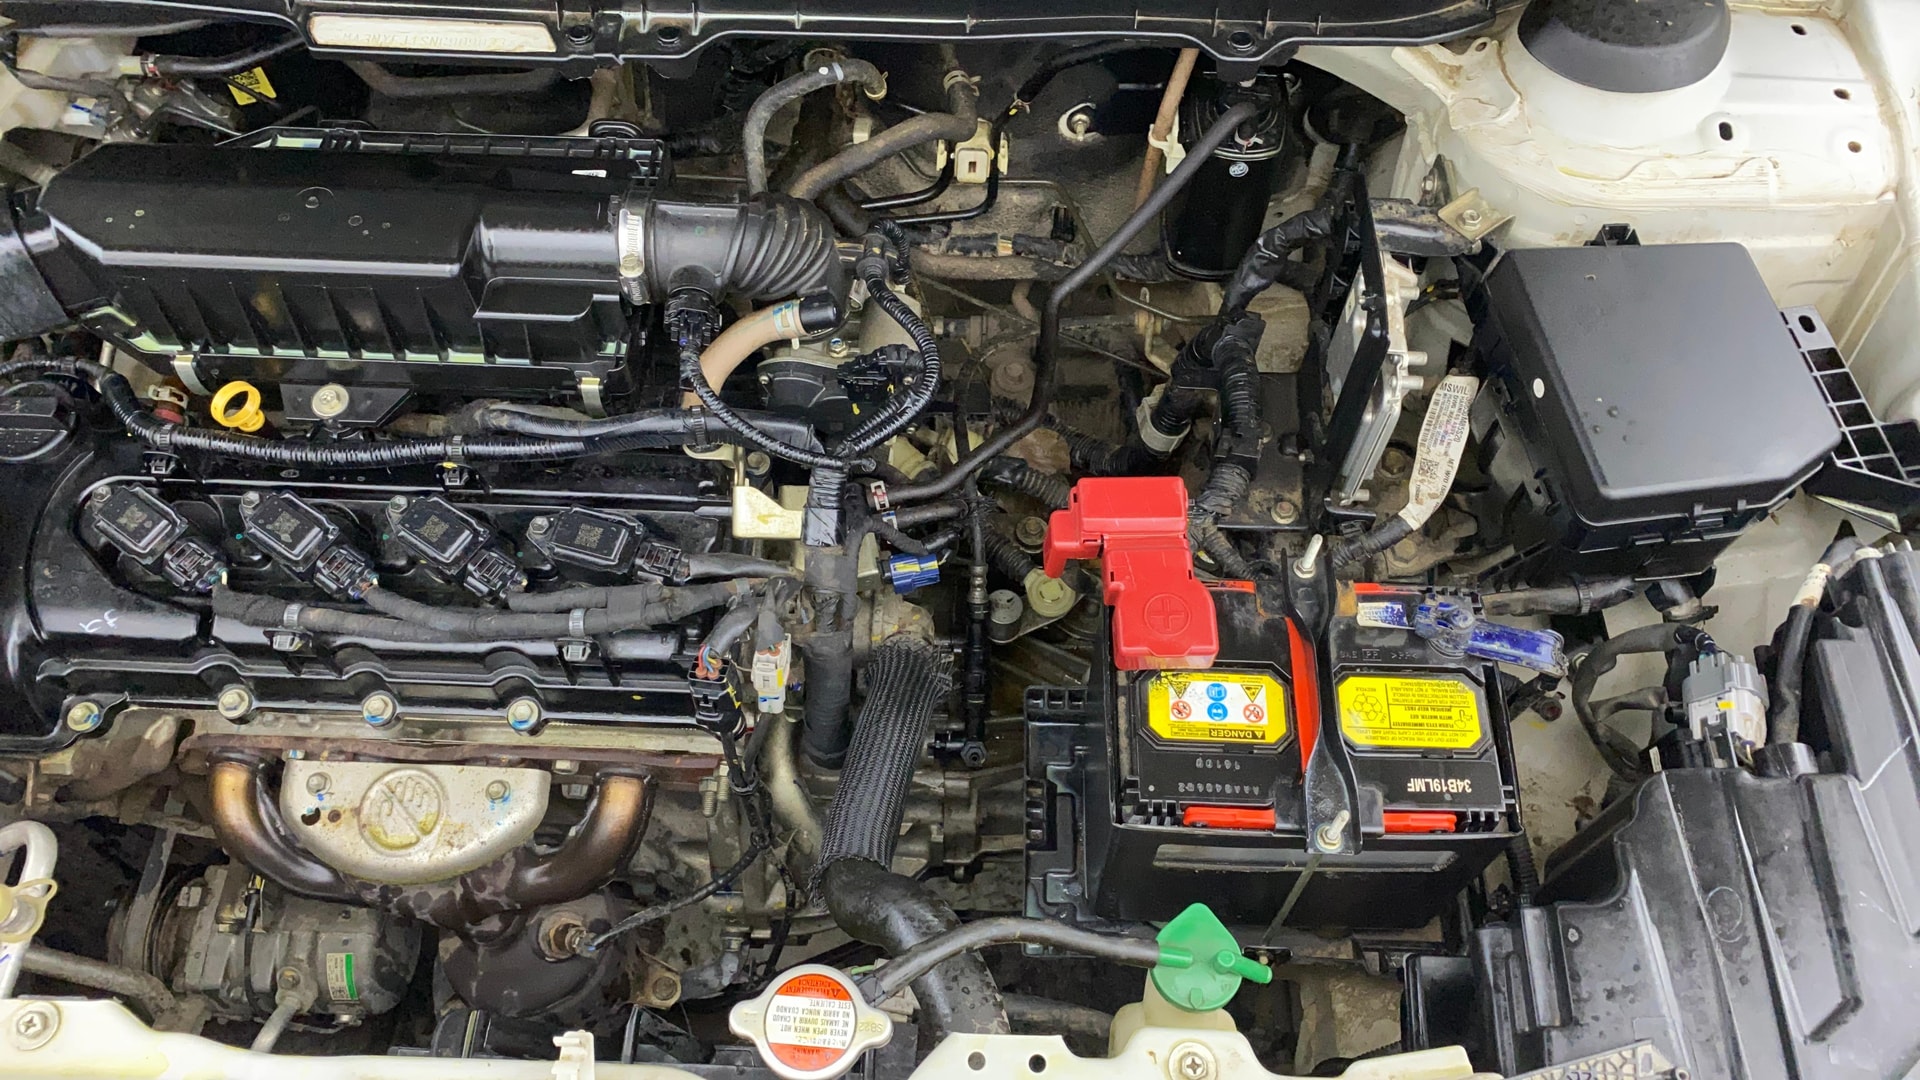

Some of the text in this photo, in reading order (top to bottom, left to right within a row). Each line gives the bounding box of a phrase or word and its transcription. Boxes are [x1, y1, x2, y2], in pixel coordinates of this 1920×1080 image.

[1440, 382, 1469, 395] MSWIL
[1210, 729, 1252, 738] DANGER
[1407, 778, 1472, 793] 34B19LMF
[798, 978, 832, 988] ADVERTENCIA
[784, 985, 830, 996] AVERTISSEMENT
[775, 1005, 799, 1014] CUANDO
[838, 1001, 851, 1009] ESTE
[801, 1007, 820, 1016] NUNCA
[823, 1009, 840, 1018] ABRIR
[798, 1016, 818, 1025] OUVRIR
[820, 1018, 840, 1027] JAMAIS
[841, 1020, 849, 1028] NE
[794, 1025, 810, 1034] WHEN
[813, 1027, 828, 1035] OPEN
[829, 1028, 848, 1037] NEVER
